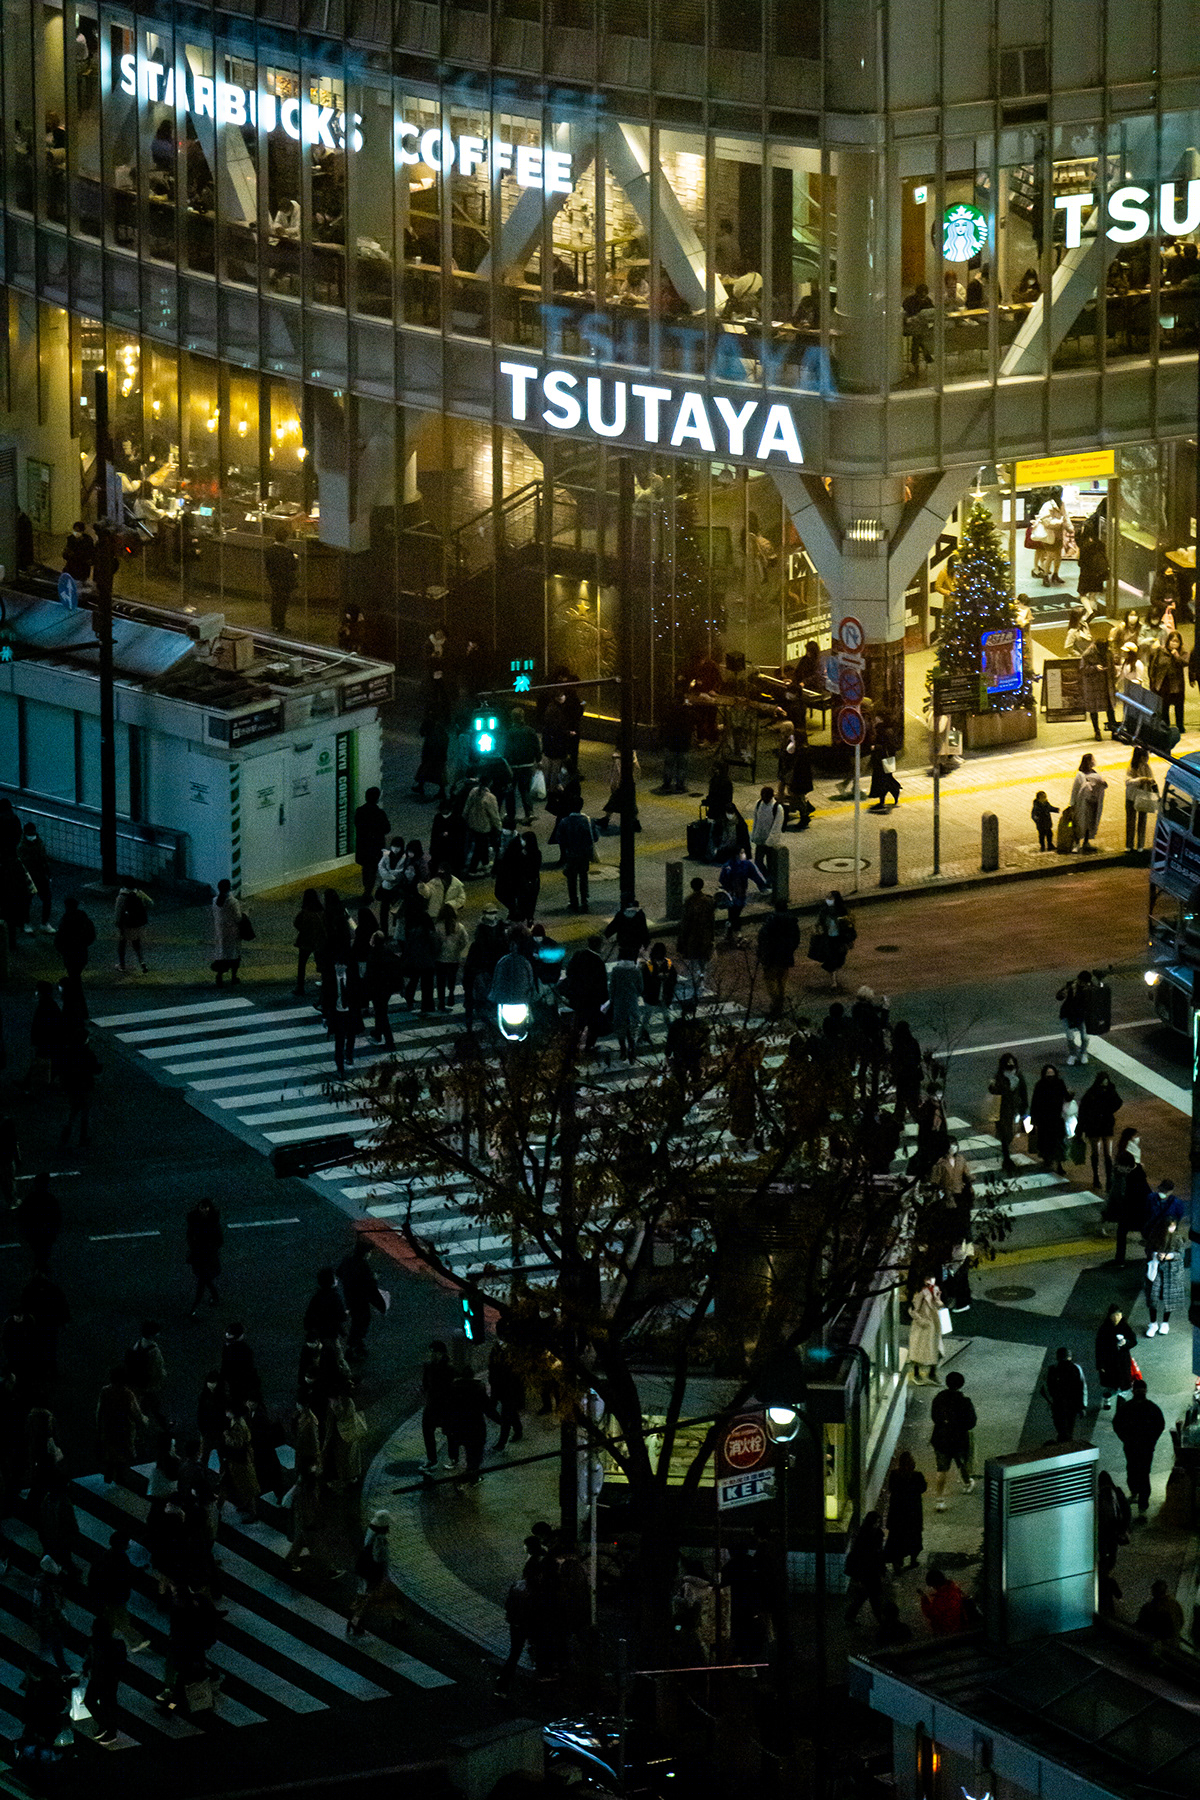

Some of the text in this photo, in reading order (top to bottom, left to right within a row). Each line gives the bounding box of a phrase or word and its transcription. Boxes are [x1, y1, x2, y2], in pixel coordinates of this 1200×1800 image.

[119, 53, 573, 194] STARBUCKS COFFEE
[500, 361, 804, 464] TSUTAYA
[338, 735, 348, 855] TOKYU CONSTRUCTION
[729, 1434, 762, 1457] 消火栓
